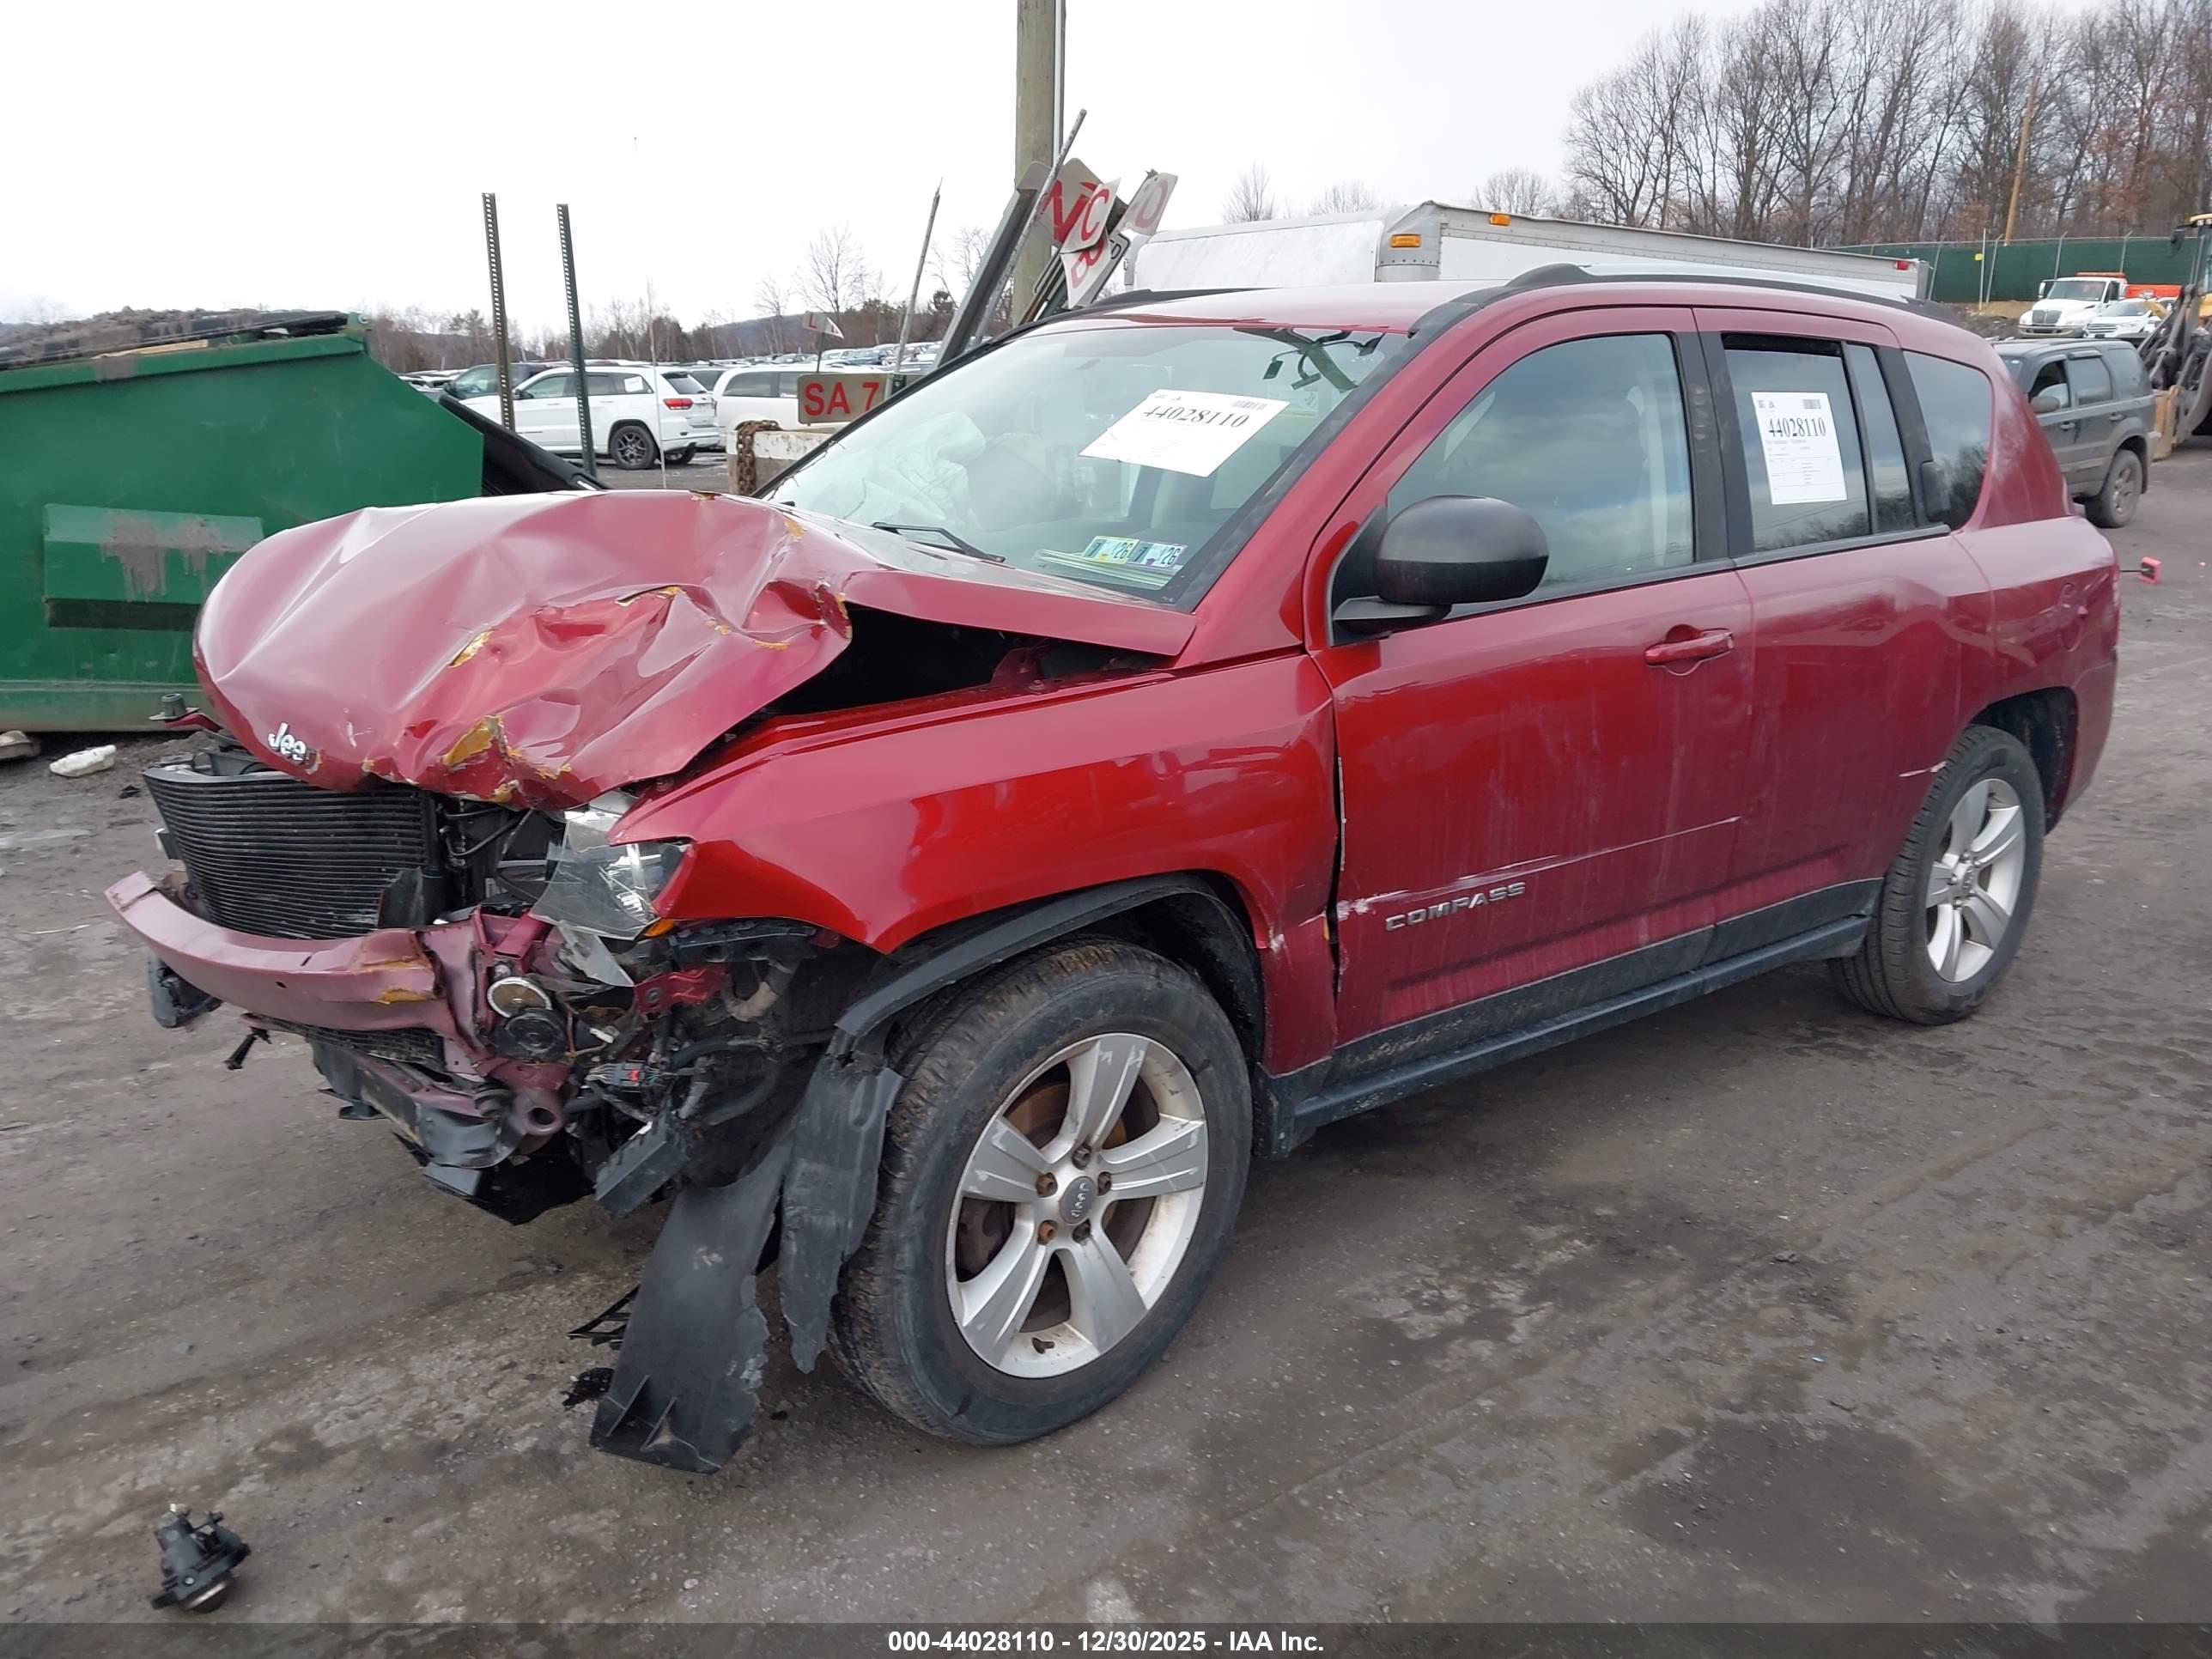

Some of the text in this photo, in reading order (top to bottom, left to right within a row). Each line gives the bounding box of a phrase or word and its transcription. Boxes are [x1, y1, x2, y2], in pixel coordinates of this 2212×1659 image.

[804, 381, 880, 416] SA 7
[1143, 405, 1250, 428] 44028110
[1768, 416, 1826, 438] 44028110
[1385, 882, 1526, 932] COMPASS
